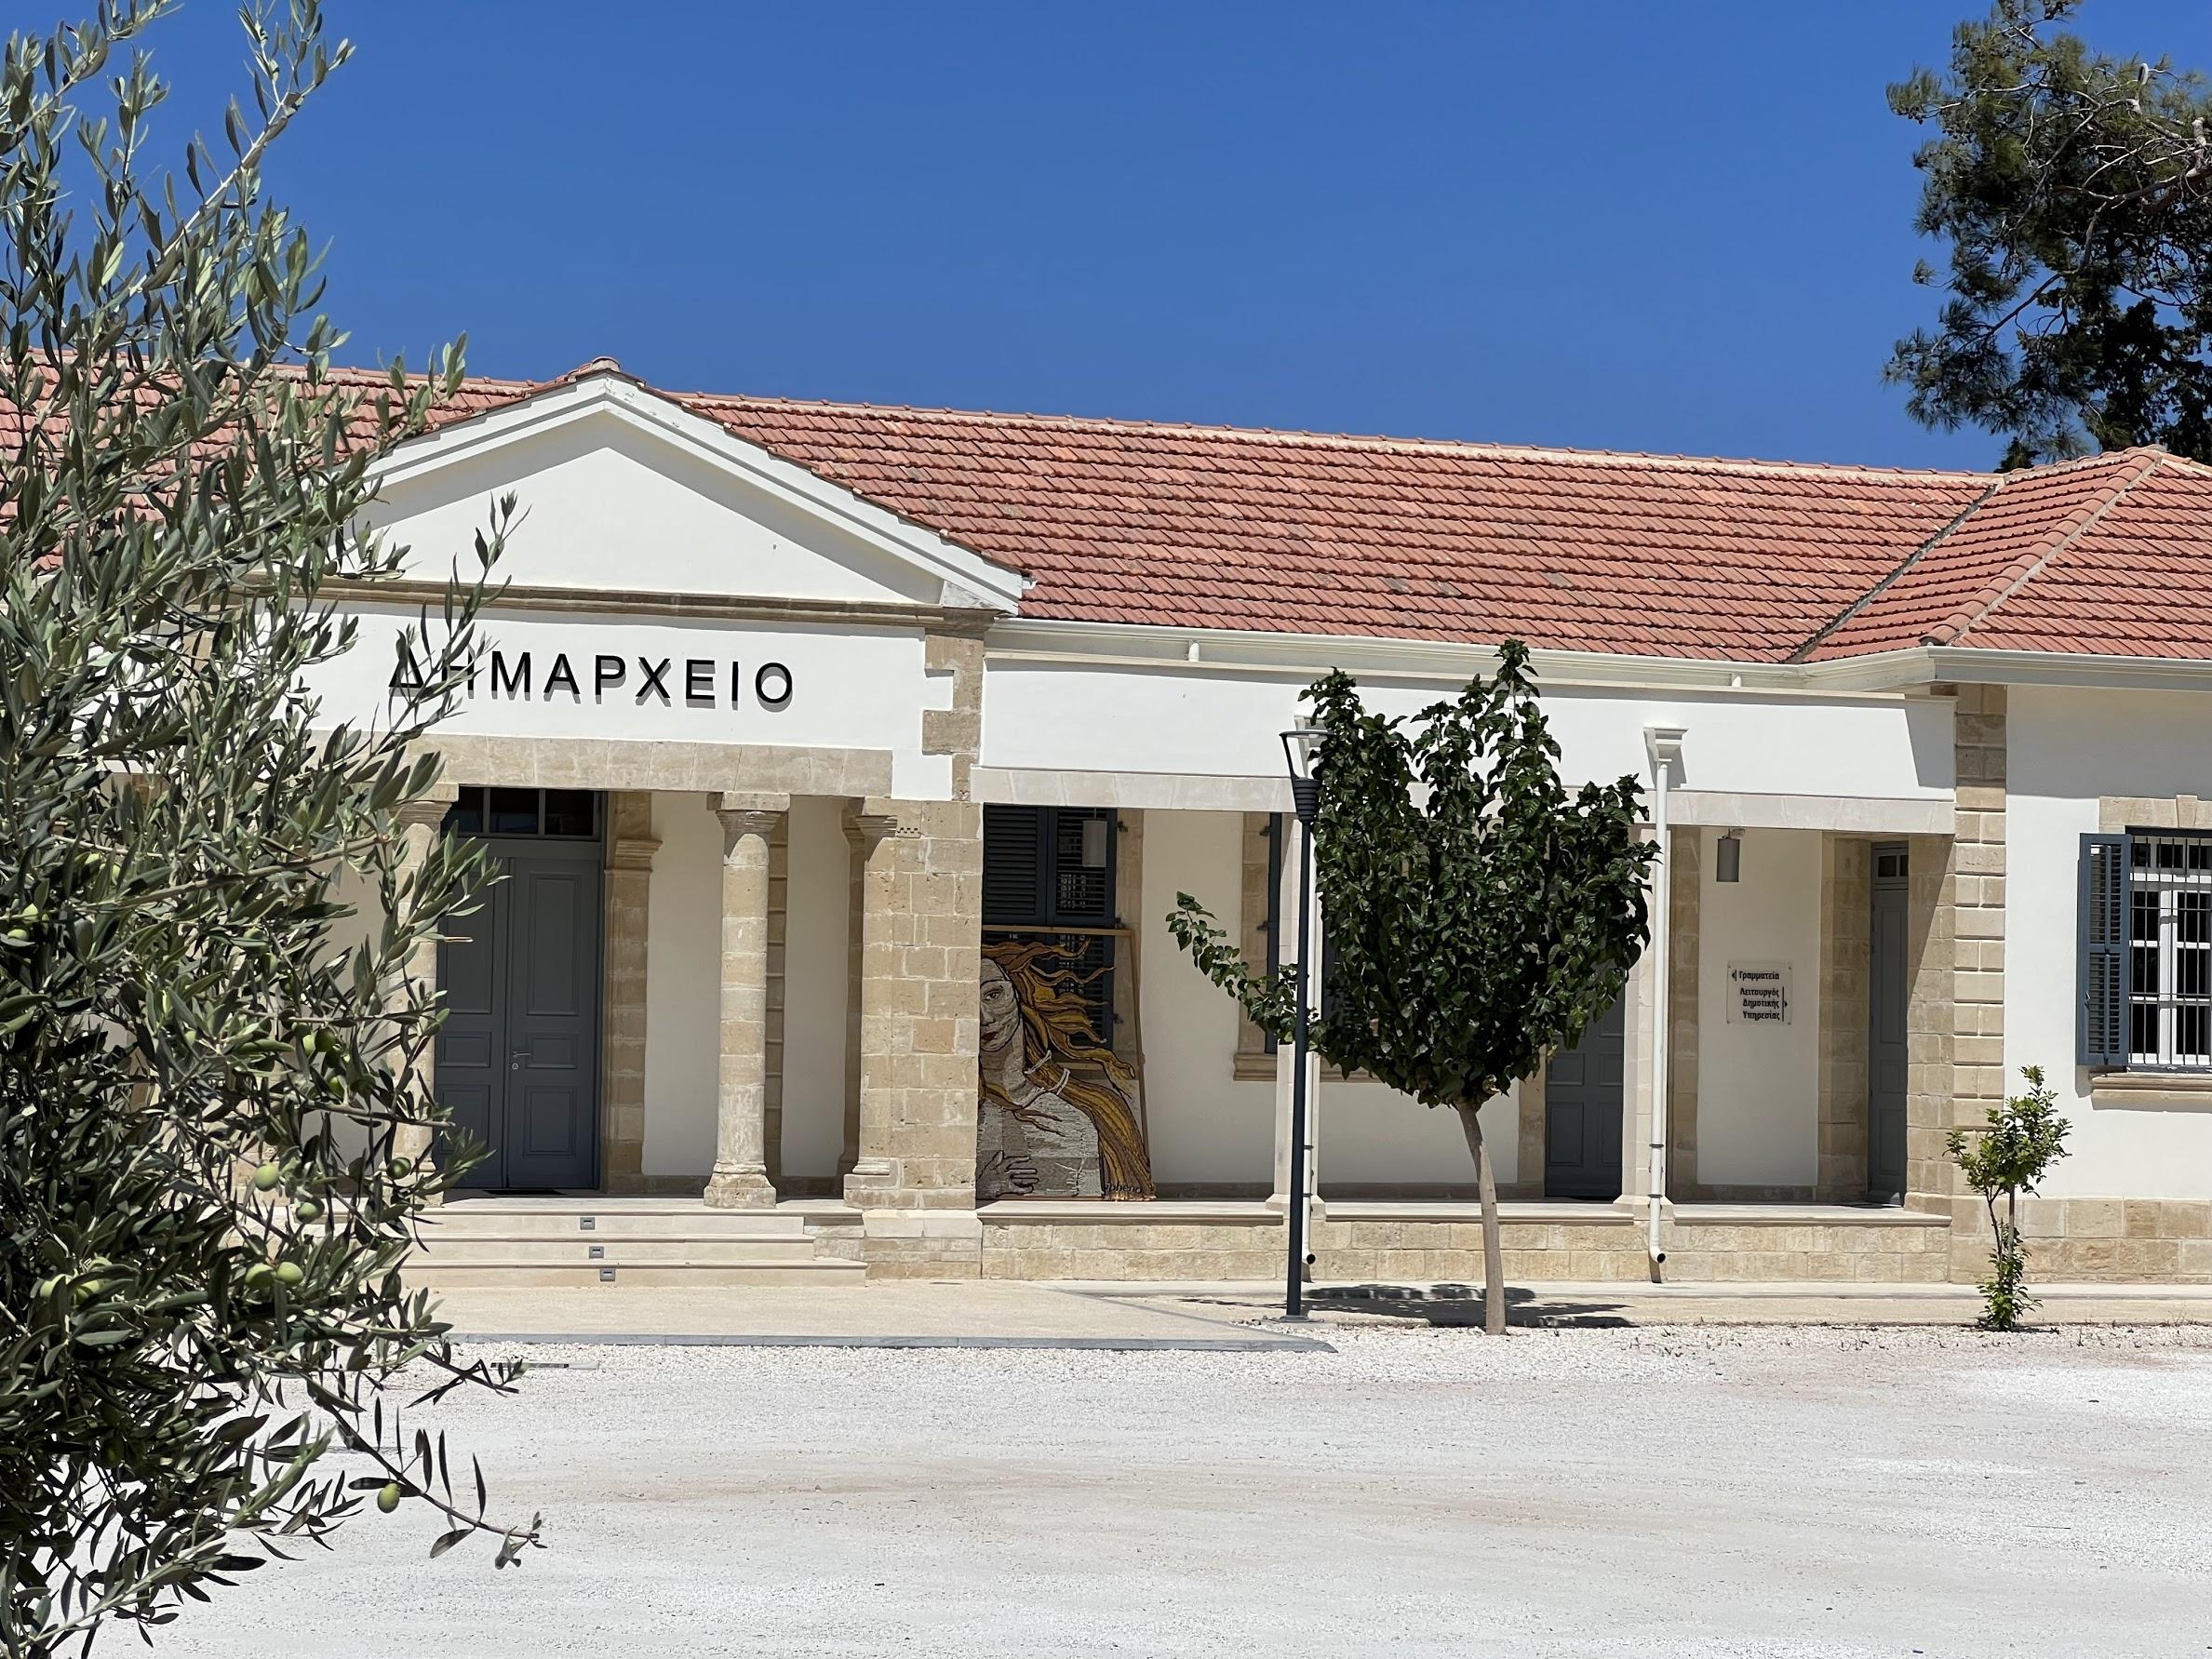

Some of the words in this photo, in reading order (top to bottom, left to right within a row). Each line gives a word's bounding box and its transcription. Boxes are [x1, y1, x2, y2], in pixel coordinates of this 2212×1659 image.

[389, 647, 794, 704] ΔΗΜΑΡΧΕΙΟ
[1738, 970, 1780, 982] Γραμματεία
[1740, 987, 1780, 998] Λειτουργός
[1743, 998, 1780, 1010] Δημοτικής
[1743, 1010, 1781, 1022] Υπηρεσίας
